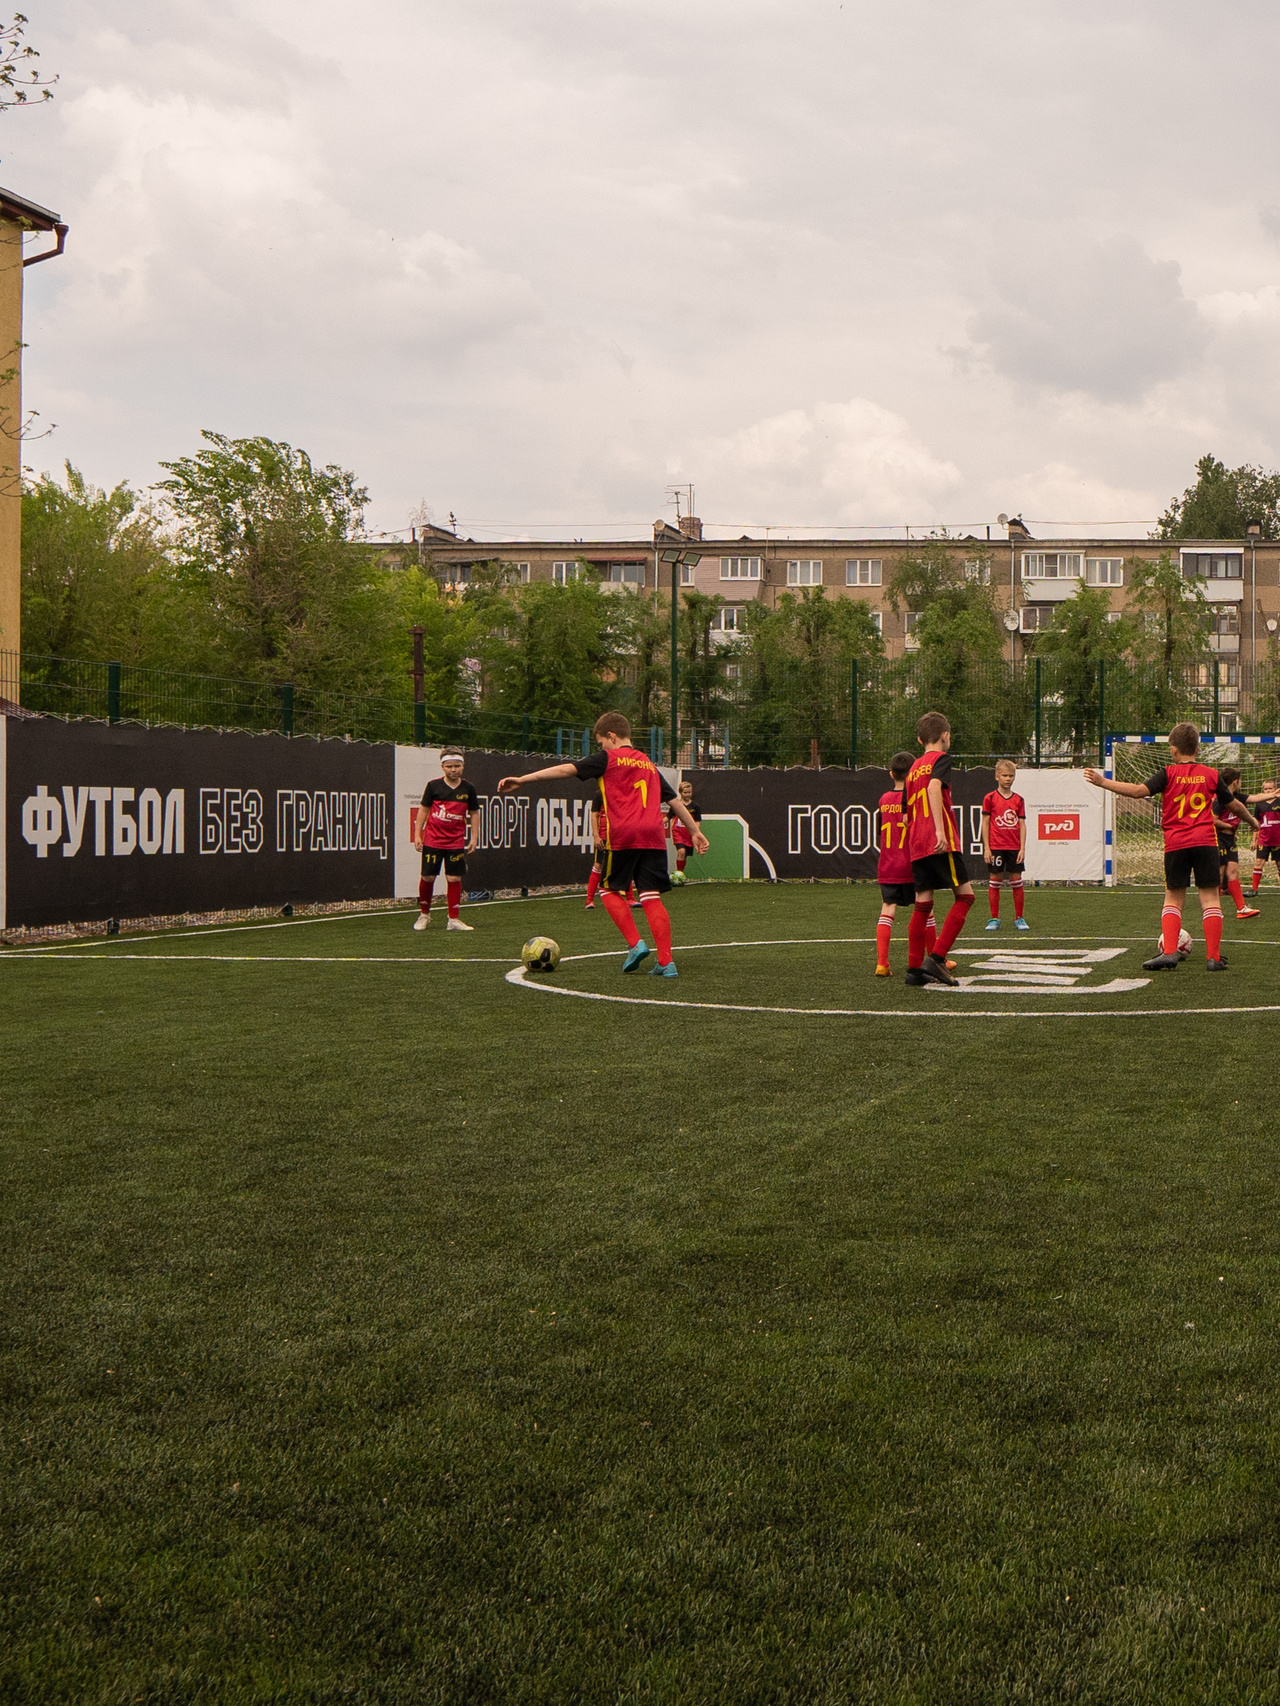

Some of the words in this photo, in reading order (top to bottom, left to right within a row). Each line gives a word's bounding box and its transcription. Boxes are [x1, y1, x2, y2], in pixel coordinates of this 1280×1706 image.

[633, 779, 647, 808] 1
[1173, 793, 1206, 818] 19
[22, 785, 185, 858] ФУТБОЛ
[199, 788, 263, 854] БЕЗ
[276, 789, 388, 860] ГРАНИЦ
[536, 797, 594, 854] ОБЪЕД
[881, 821, 907, 849] 17
[425, 853, 437, 864] 11
